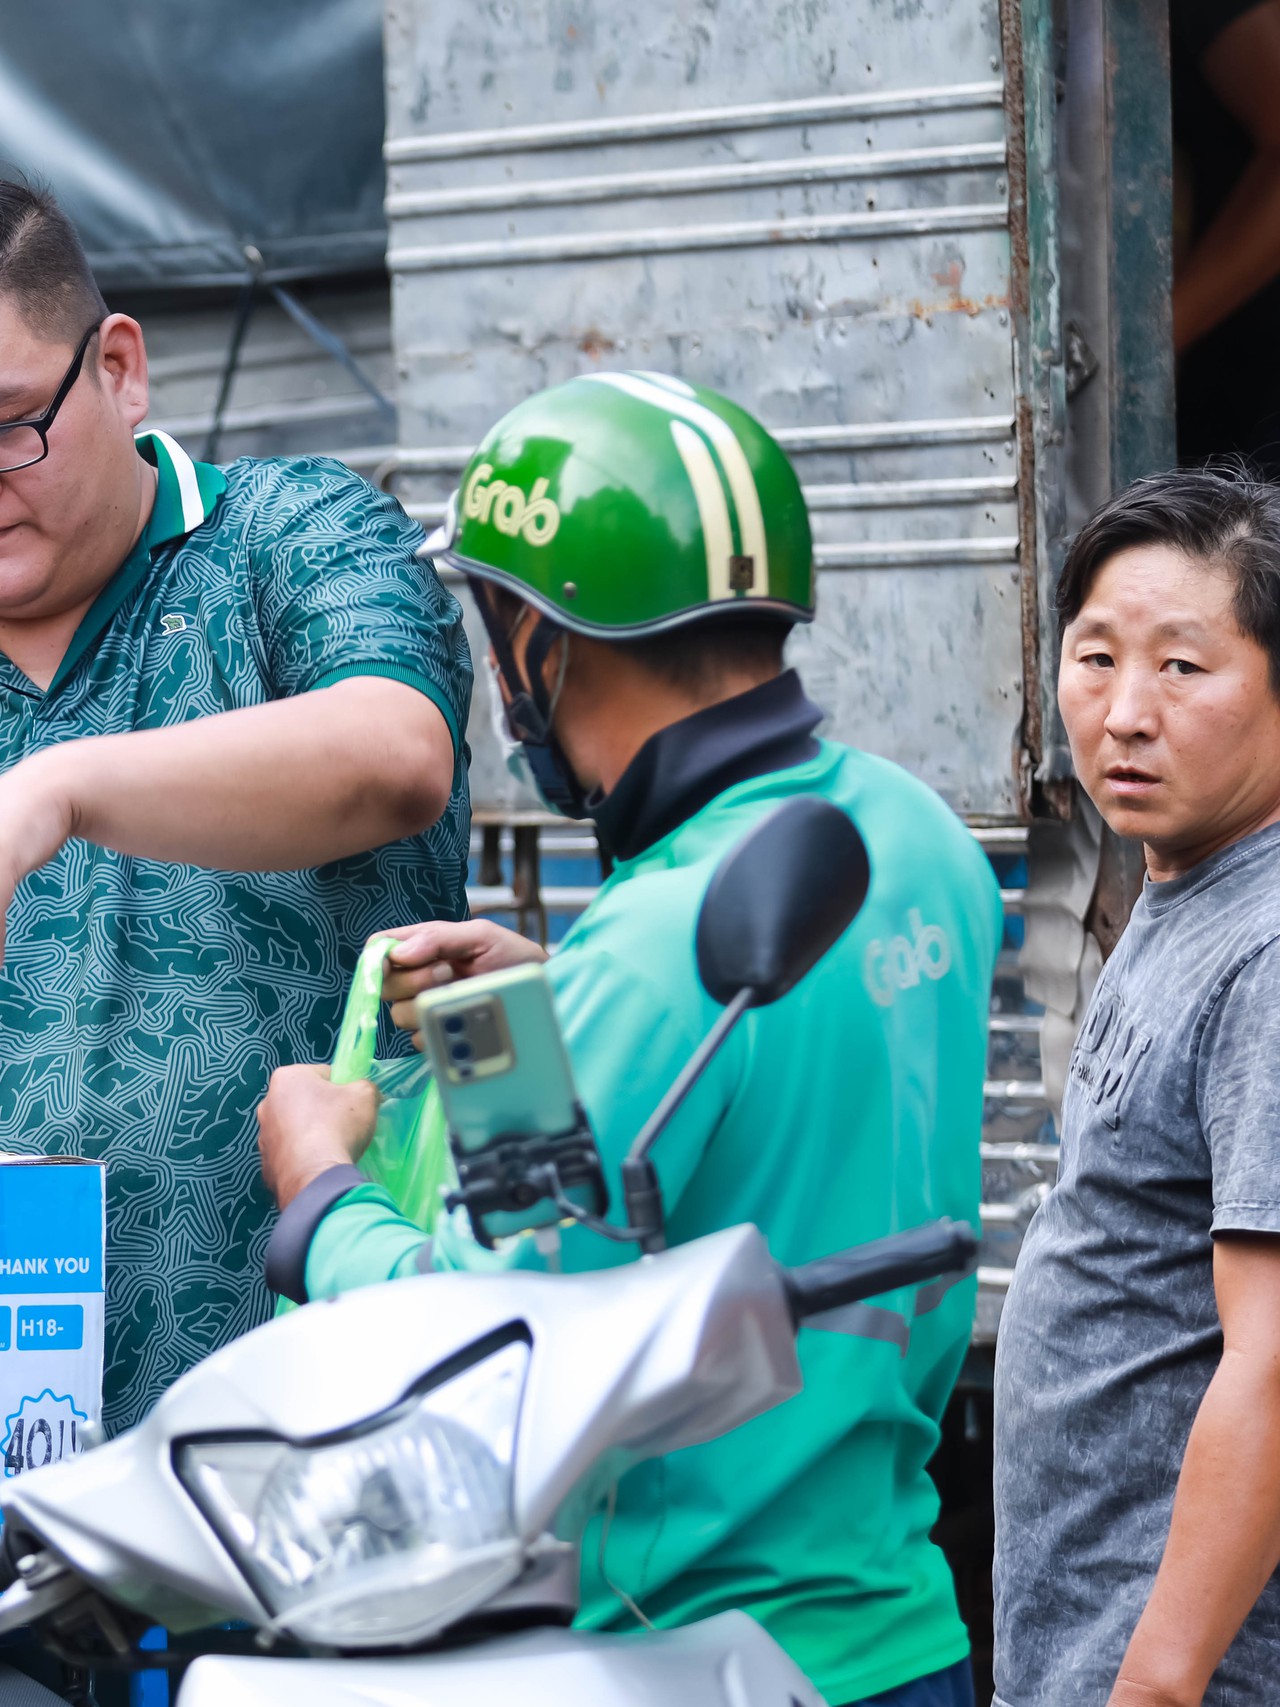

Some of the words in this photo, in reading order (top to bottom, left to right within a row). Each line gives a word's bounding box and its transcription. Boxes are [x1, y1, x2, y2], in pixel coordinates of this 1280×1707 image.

[464, 463, 560, 547] Grab
[862, 907, 952, 1007] Gab
[54, 1257, 90, 1275] YOU
[21, 1319, 64, 1337] H18-
